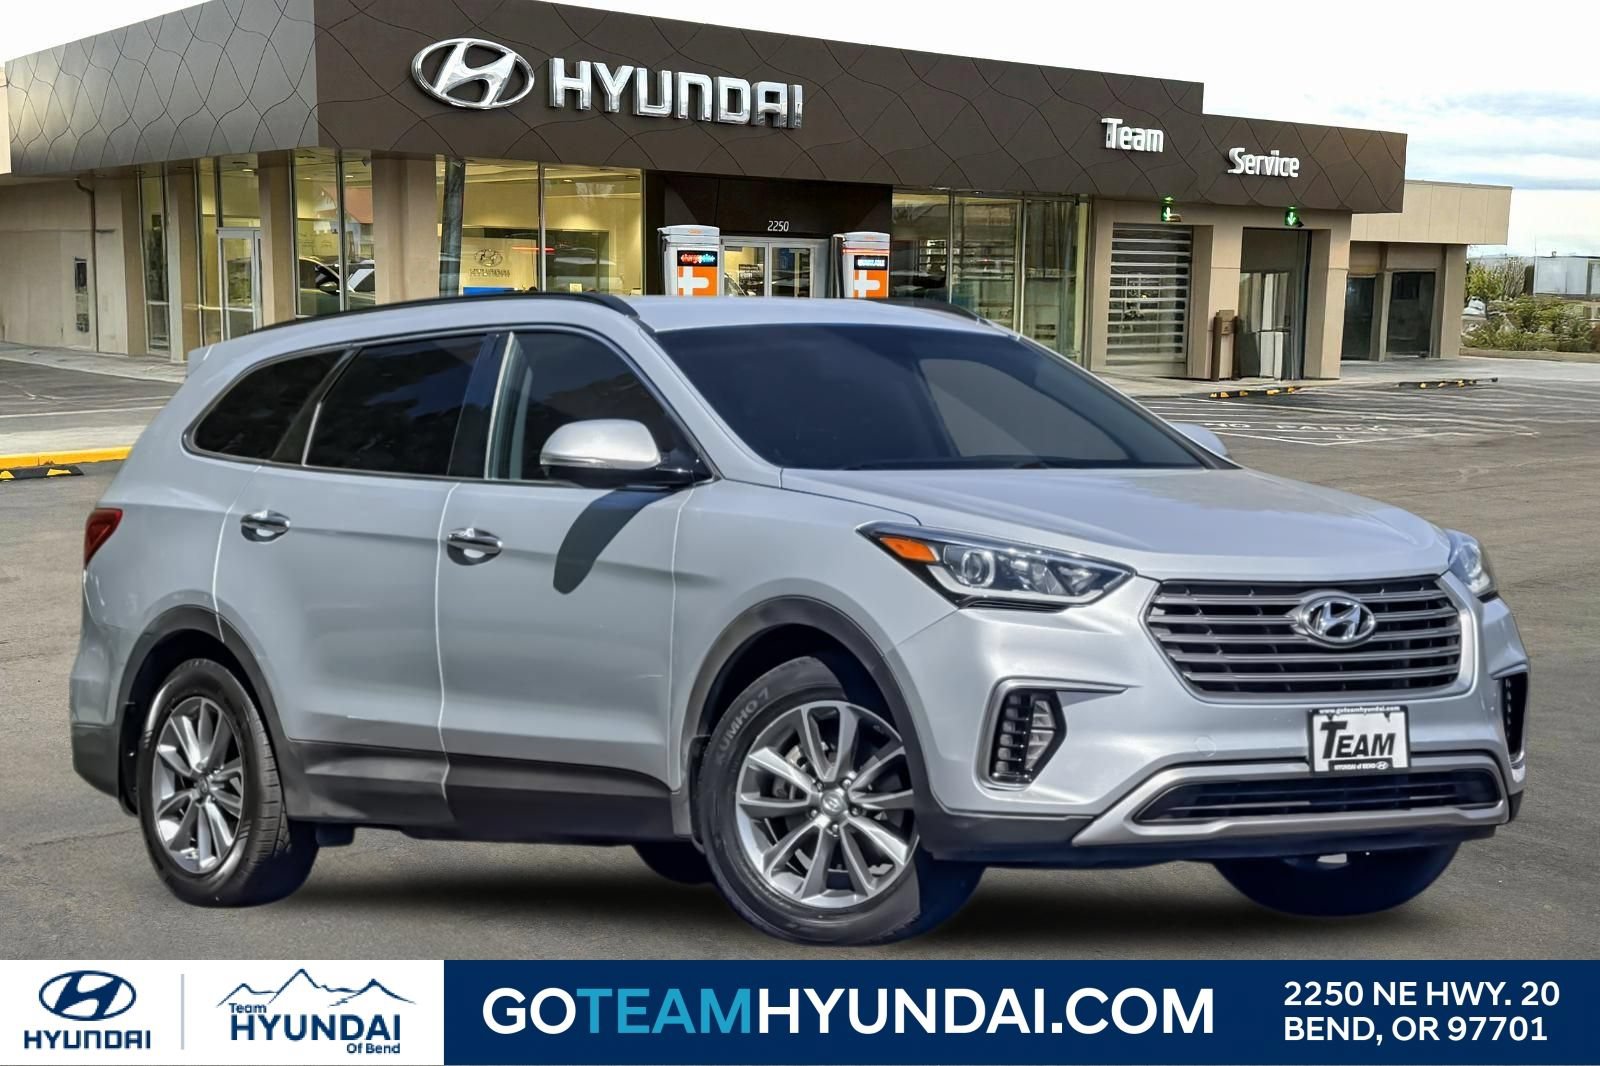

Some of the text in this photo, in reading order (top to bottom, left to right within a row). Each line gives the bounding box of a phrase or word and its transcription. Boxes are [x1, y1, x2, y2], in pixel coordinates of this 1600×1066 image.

[549, 57, 803, 129] HYUNDAI
[1101, 117, 1164, 152] Team
[1227, 147, 1300, 178] Service
[767, 220, 790, 232] 2250
[1320, 721, 1396, 759] TEAM
